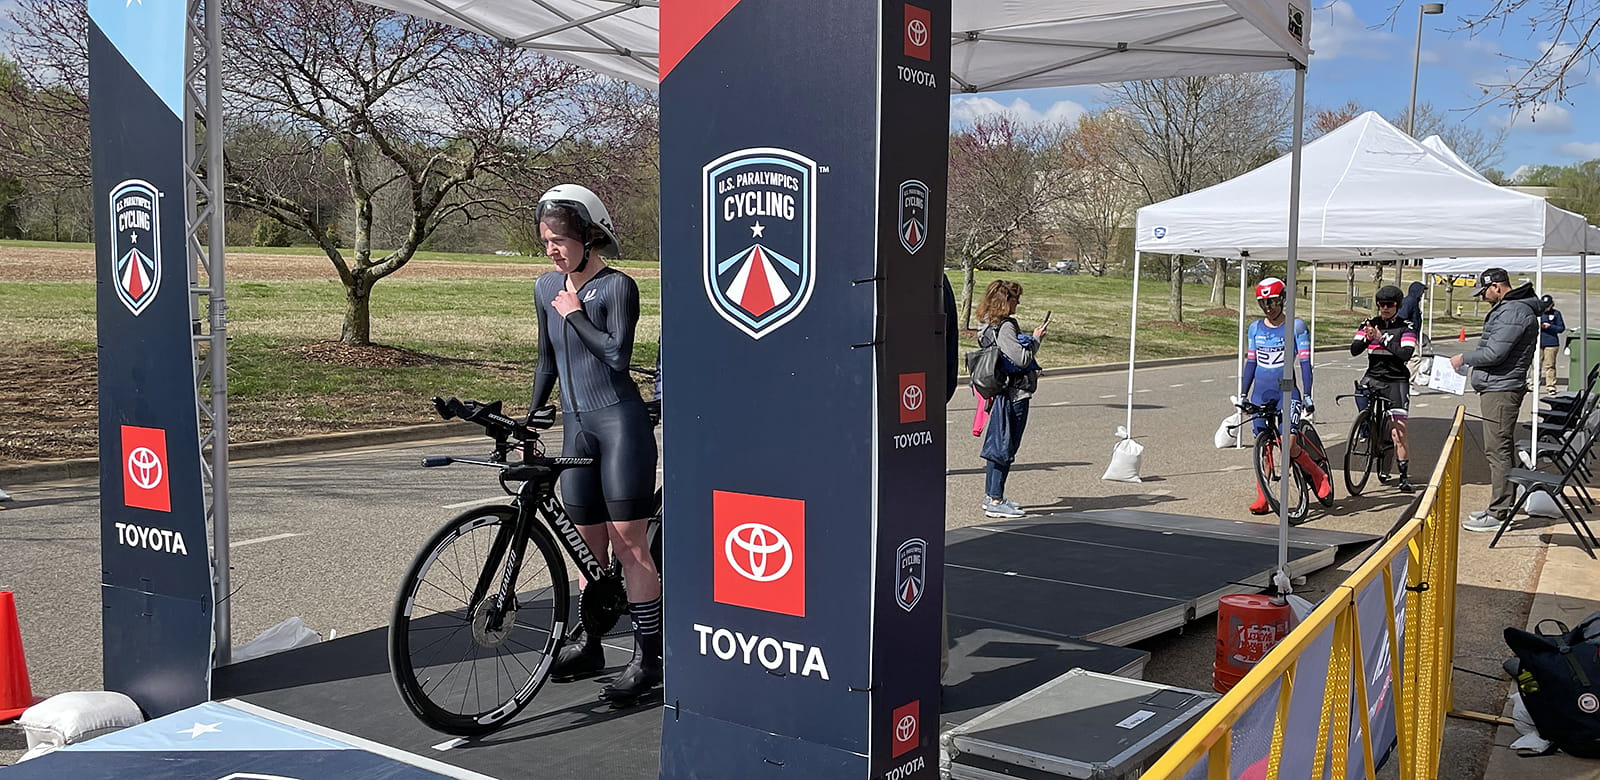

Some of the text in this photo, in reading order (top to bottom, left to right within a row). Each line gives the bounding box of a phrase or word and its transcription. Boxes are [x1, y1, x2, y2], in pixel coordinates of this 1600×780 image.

[897, 65, 936, 88] TOYOTA
[719, 171, 799, 194] U.S. PARALYMPICS
[724, 191, 795, 221] CYCLING
[119, 210, 150, 232] CYCLING
[893, 431, 932, 449] TOYOTA
[115, 522, 187, 555] TOYOTA
[543, 497, 606, 581] S-WORKS
[693, 623, 830, 681] TOYOTA
[885, 756, 925, 780] TOYOTA
